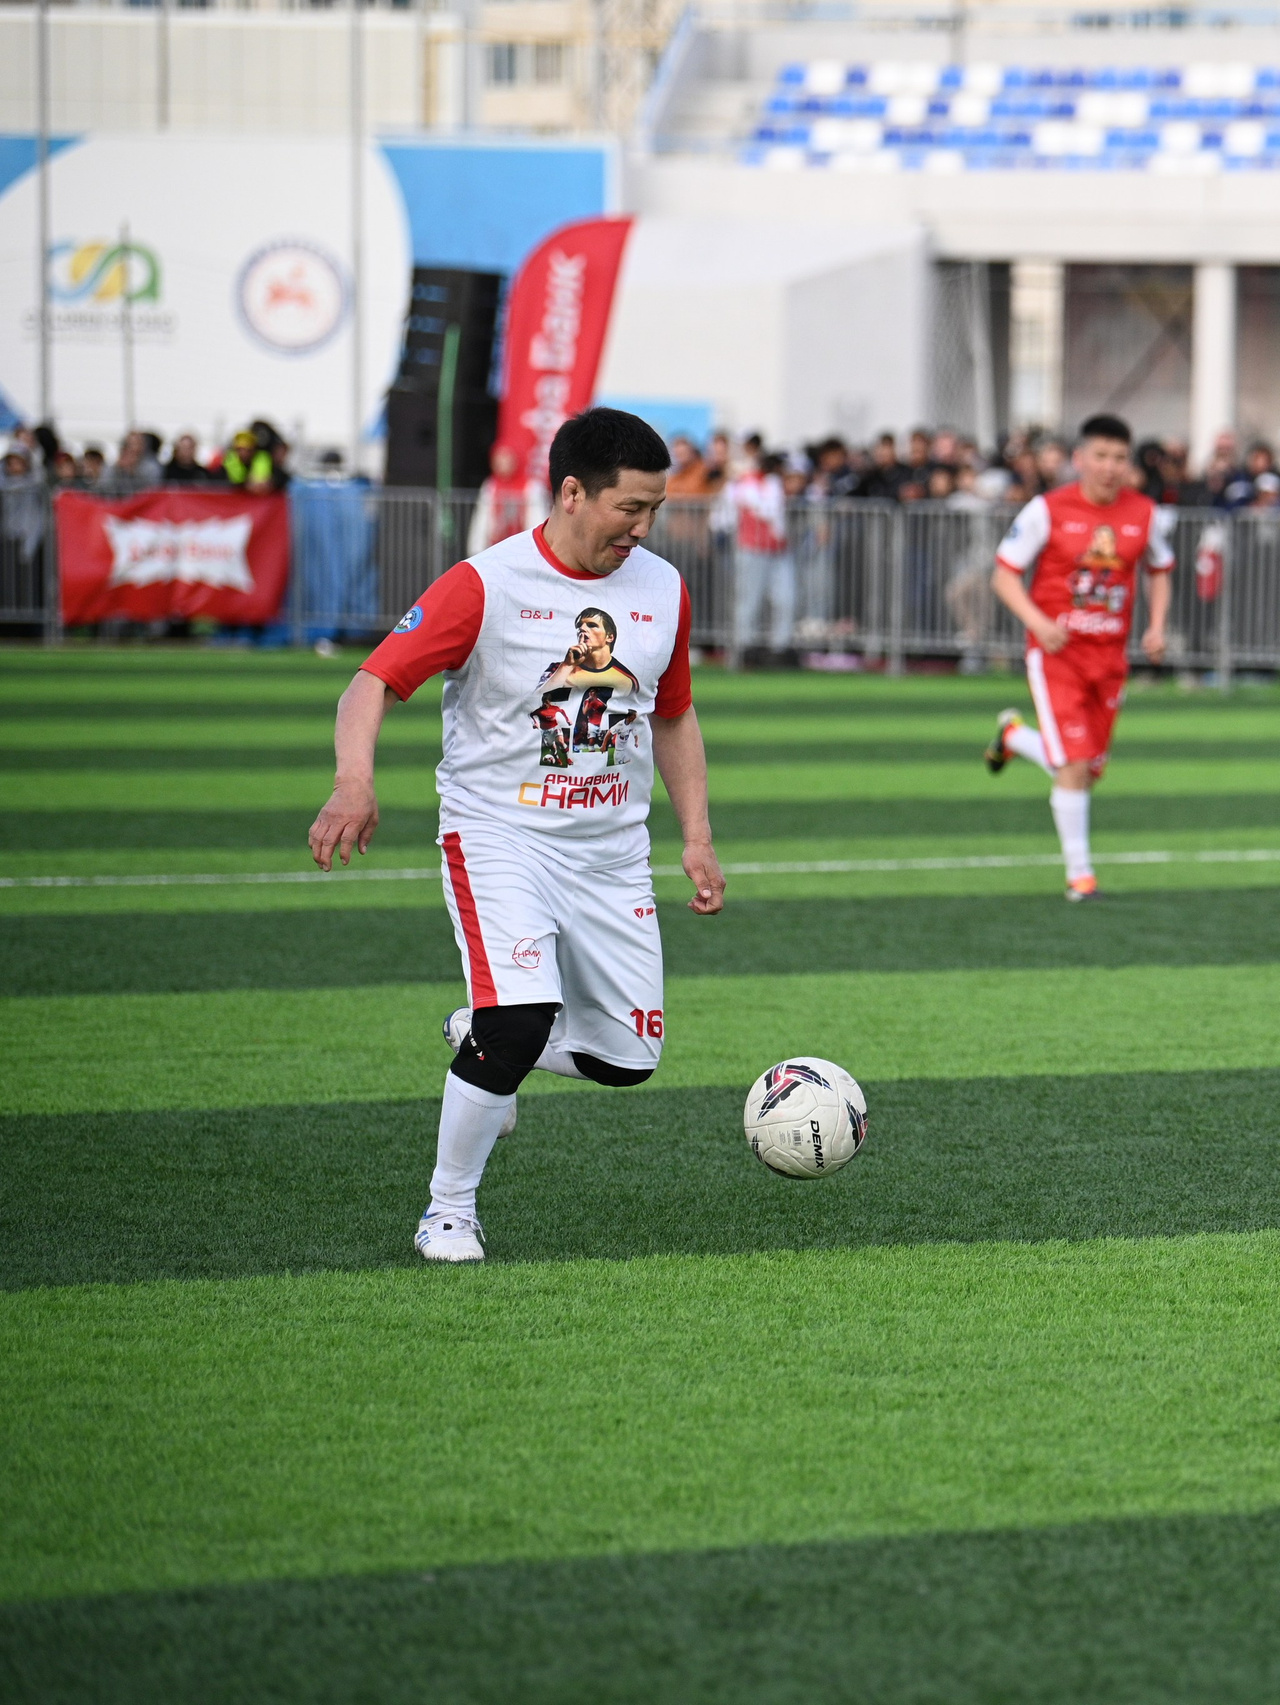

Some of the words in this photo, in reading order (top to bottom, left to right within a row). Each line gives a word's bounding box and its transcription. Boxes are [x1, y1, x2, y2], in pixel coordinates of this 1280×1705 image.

[520, 609, 553, 620] O&J
[544, 772, 620, 787] АРШАВИН
[518, 780, 629, 809] СНАМИ
[630, 1008, 663, 1038] 16
[810, 1119, 825, 1169] DEMIX
